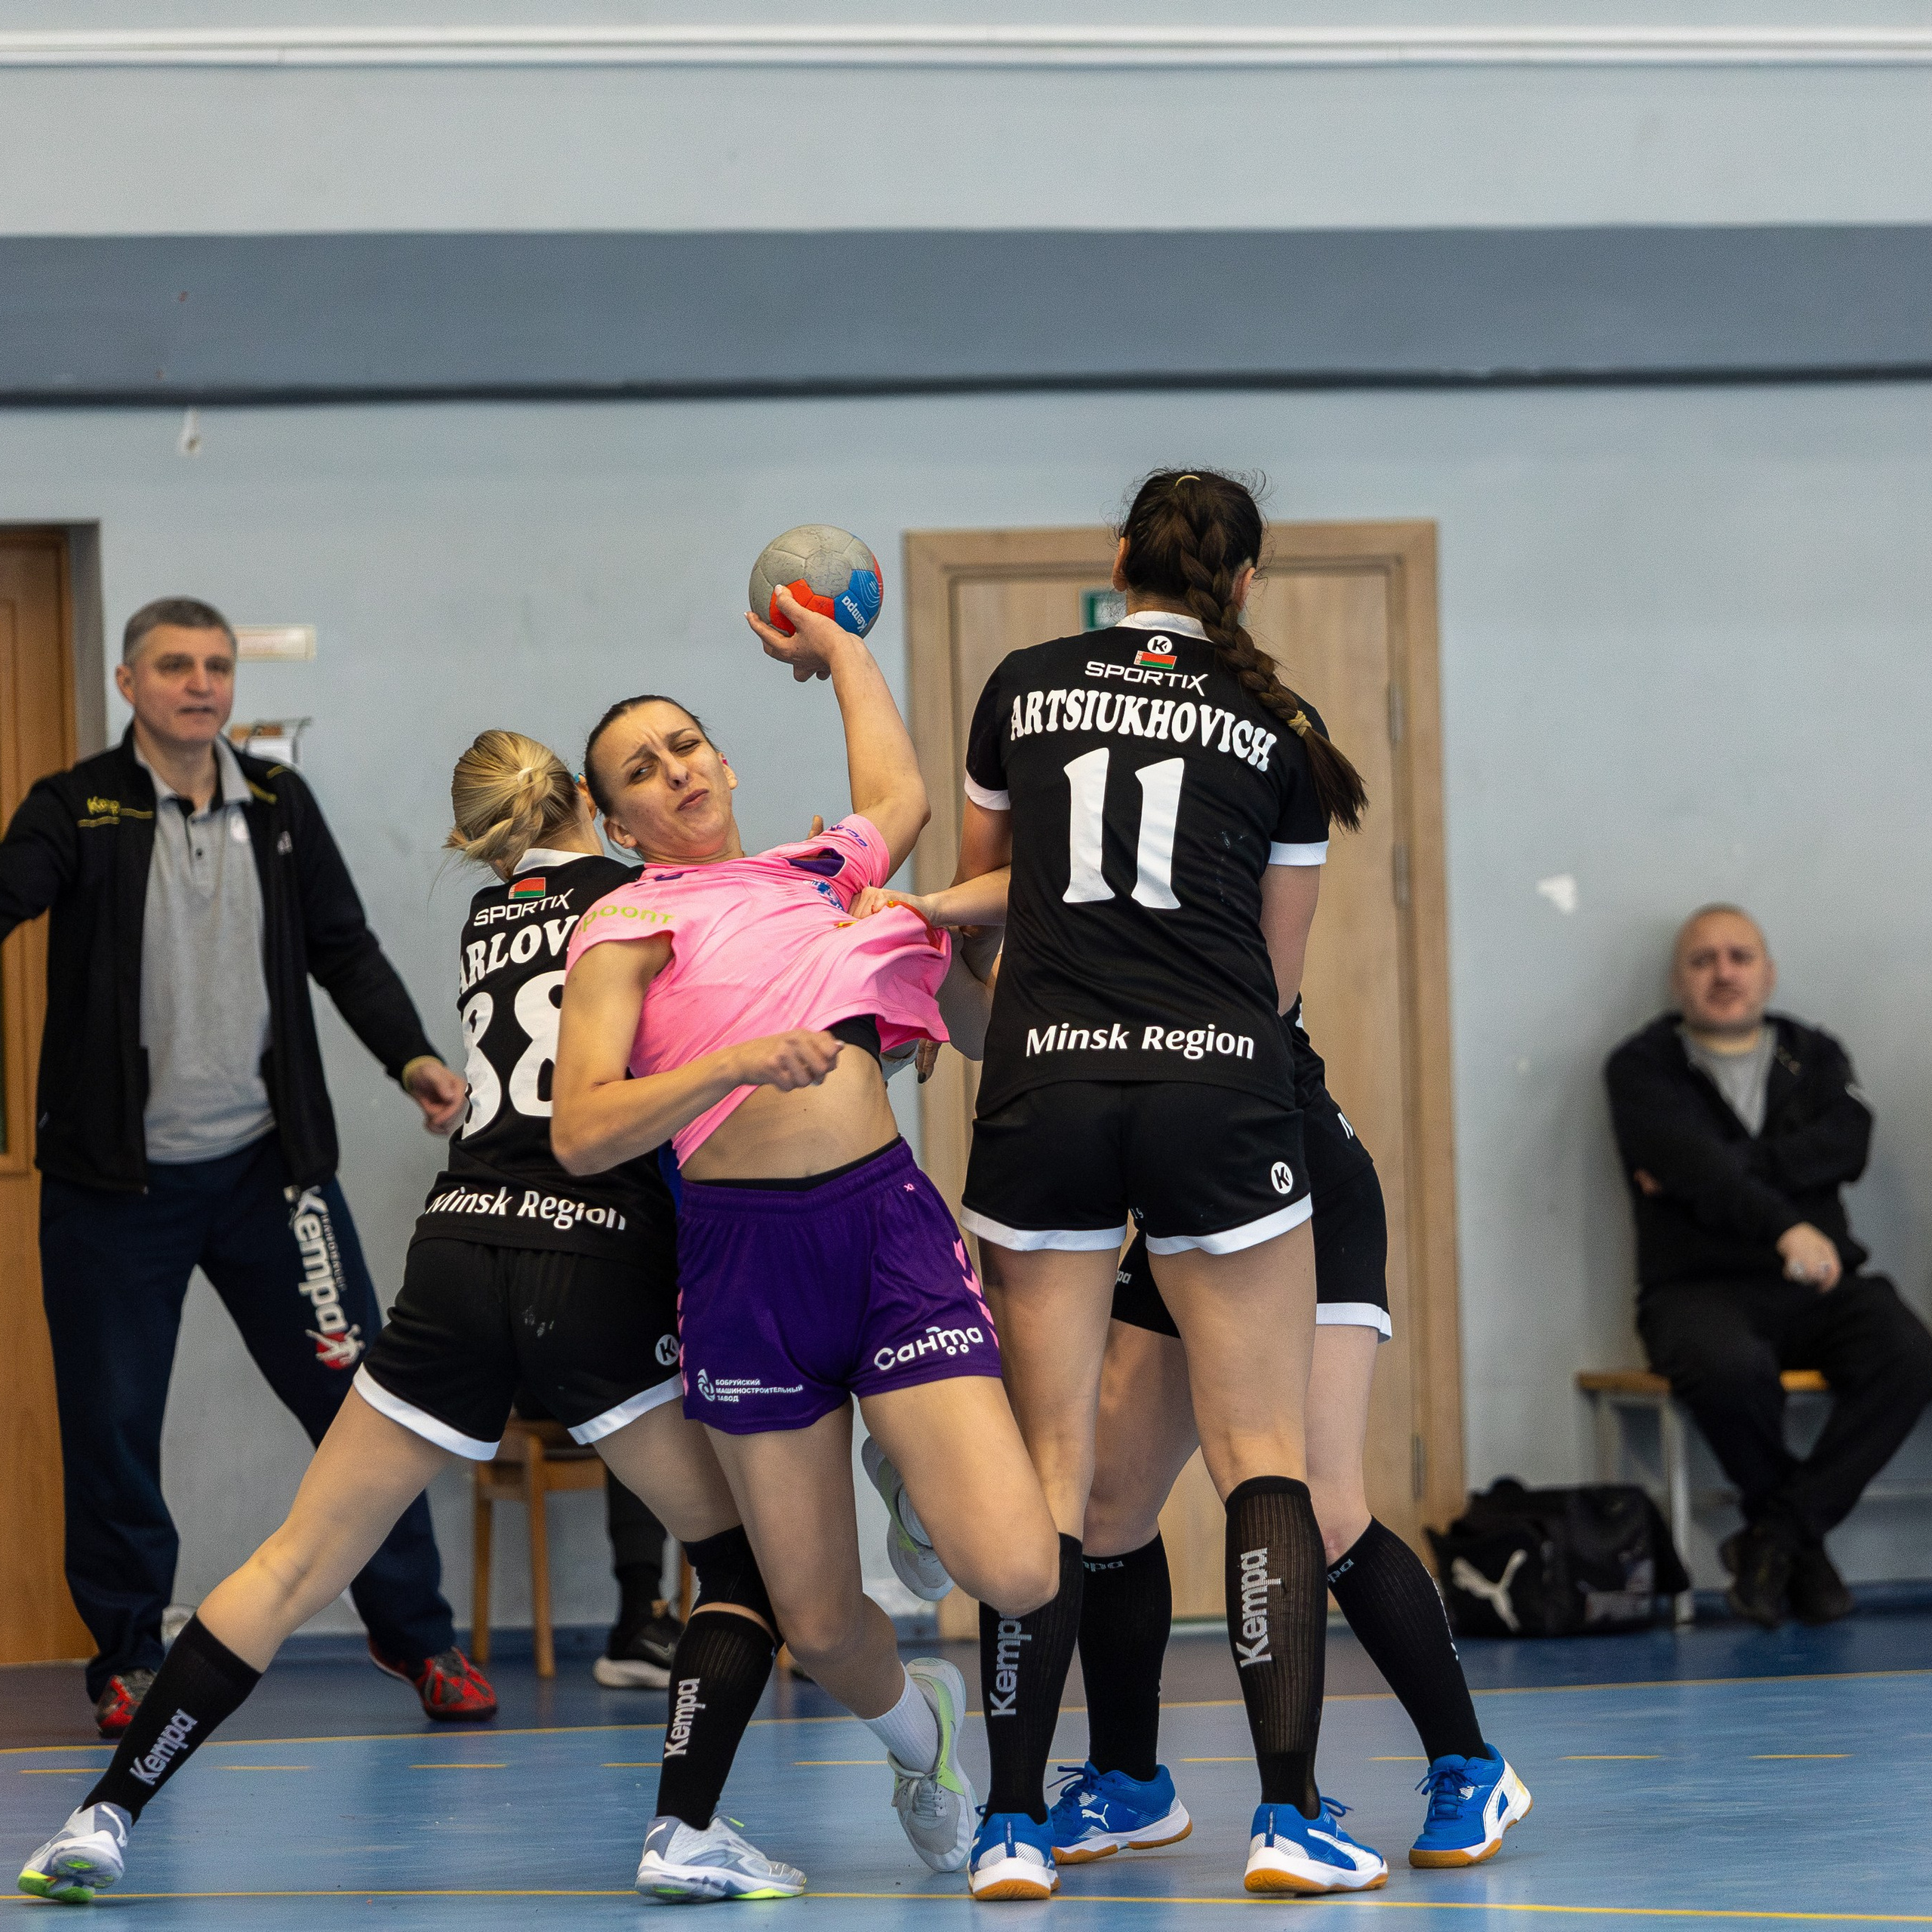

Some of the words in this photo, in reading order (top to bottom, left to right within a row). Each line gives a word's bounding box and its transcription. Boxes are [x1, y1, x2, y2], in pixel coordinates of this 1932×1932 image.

[841, 596, 868, 632] Kempa
[1085, 661, 1208, 696] SPORTIX
[1011, 689, 1277, 771] ARTSIUKHOVICH
[1063, 747, 1185, 909] 11
[474, 888, 574, 926] SPORTIX
[459, 915, 580, 995] ARLOV
[1026, 1023, 1130, 1057] Minsk
[1142, 1024, 1254, 1060] Region
[426, 1186, 512, 1214] Minsk
[517, 1190, 626, 1230] Region
[716, 1384, 804, 1394] МАШИНОСТРОИТЕЛЬНЫЙ
[1235, 1547, 1282, 1668] Kempa
[989, 1612, 1032, 1717] Kemp
[130, 1709, 198, 1785] Kempa
[664, 1678, 706, 1758] Kempa
